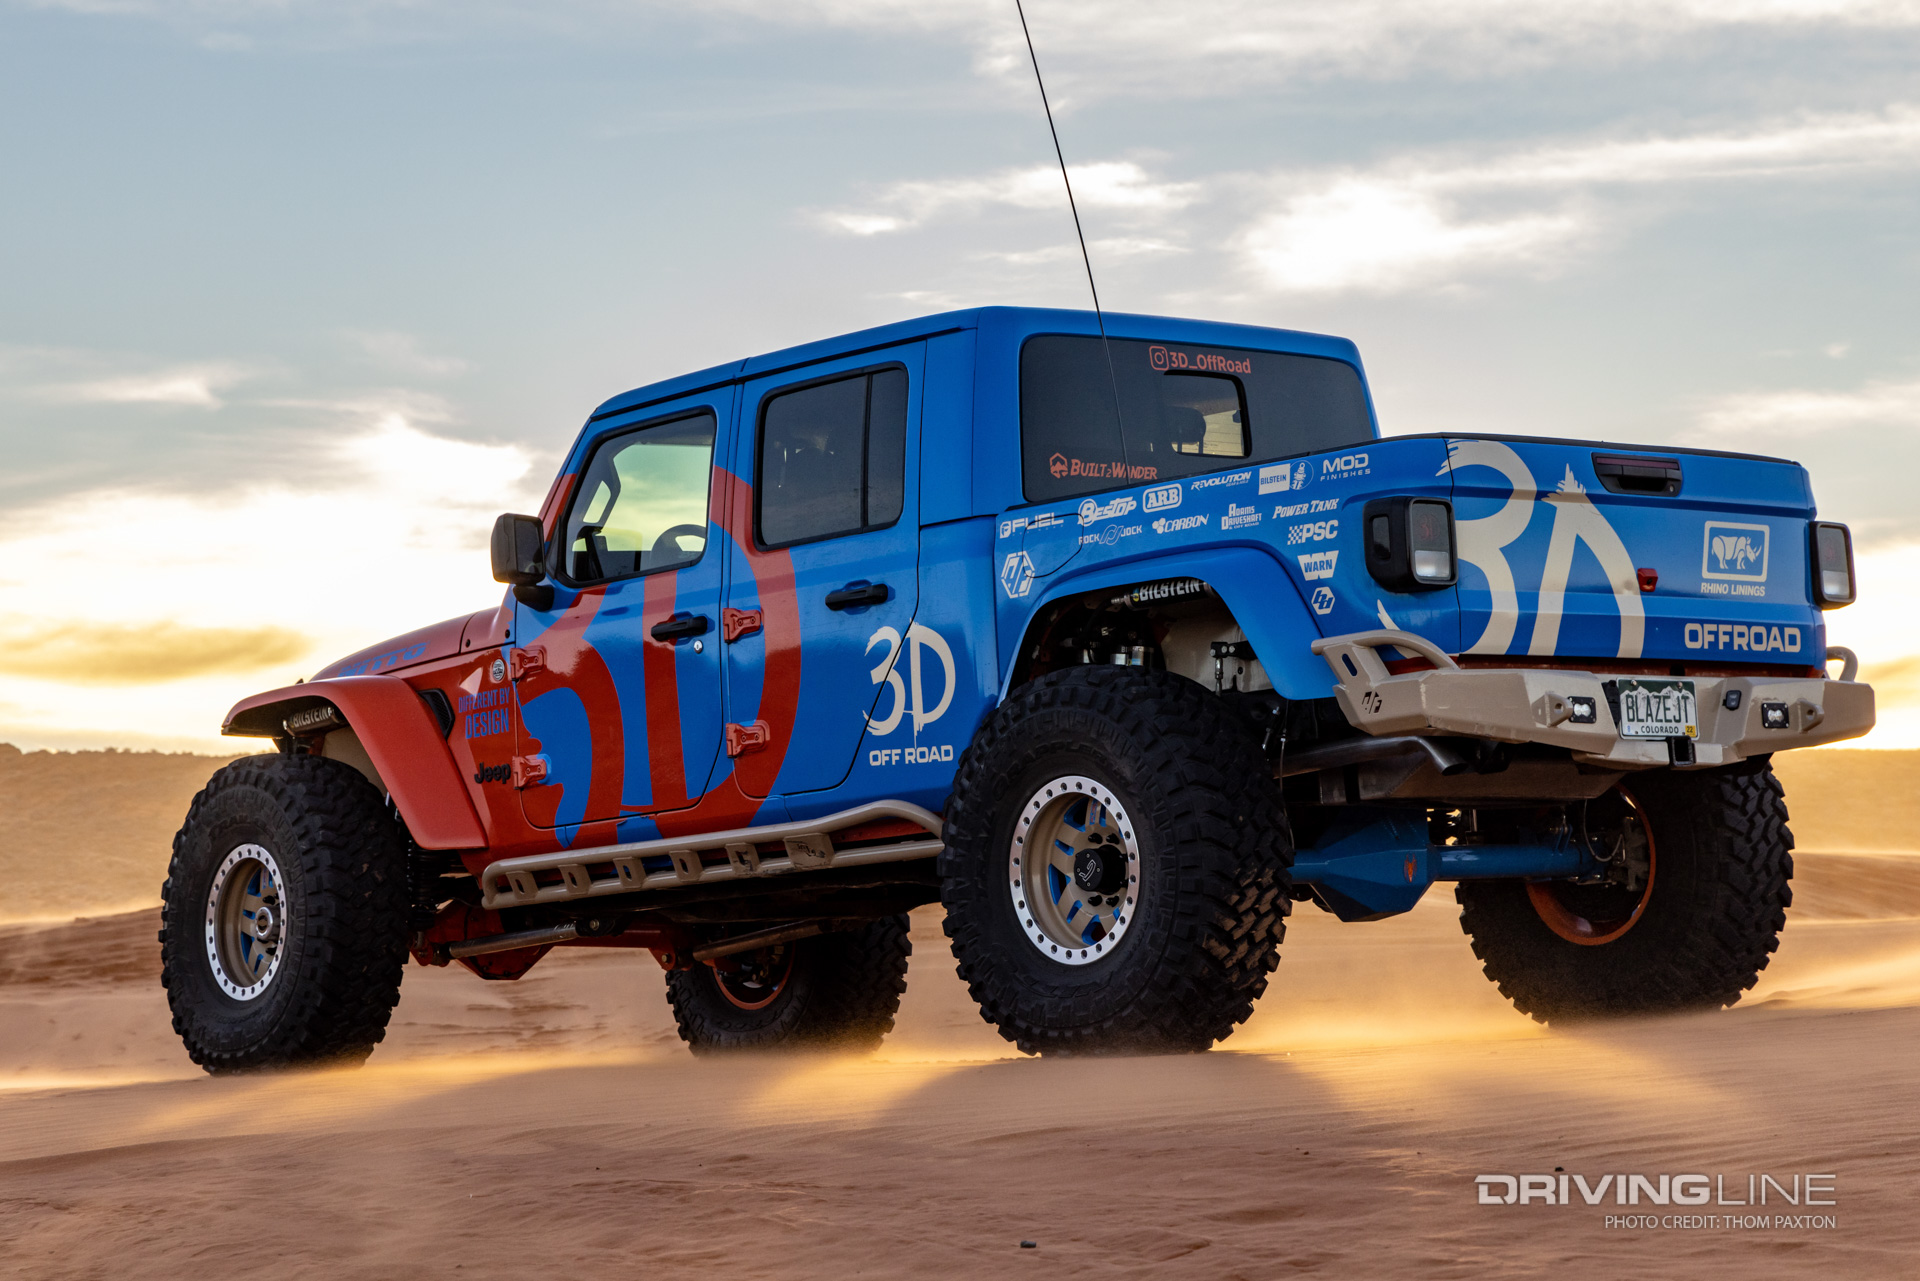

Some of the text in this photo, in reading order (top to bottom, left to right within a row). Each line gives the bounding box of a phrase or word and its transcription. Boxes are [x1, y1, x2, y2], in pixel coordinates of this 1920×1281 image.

[1169, 351, 1252, 374] 3D_OffRoad
[1322, 453, 1369, 474] MOD
[1190, 471, 1252, 491] REVOLUTION
[1260, 474, 1287, 485] BILSTEIN
[1320, 468, 1371, 482] FINISHES
[1146, 488, 1179, 509] ARB
[1272, 498, 1340, 519] POWER TANK
[1012, 512, 1064, 533] FUEL
[1165, 513, 1209, 533] CARBON
[1301, 519, 1339, 544] PSC
[1078, 525, 1143, 545] ROCK JOCK
[1303, 559, 1333, 573] WARN
[1140, 579, 1201, 602] BILSTEIN
[1700, 582, 1766, 597] RHINO LININGS
[1684, 622, 1802, 653] OFFROAD
[862, 617, 956, 747] 3D
[458, 687, 510, 713] DIFFERENT BY
[1625, 693, 1690, 723] BLAZEJT
[293, 706, 329, 728] BILSTEIN
[465, 708, 510, 740] DESIGN
[1640, 725, 1680, 734] COLORADO
[1686, 725, 1694, 733] 22
[869, 745, 954, 766] OFF ROAD
[474, 762, 511, 784] Jeep
